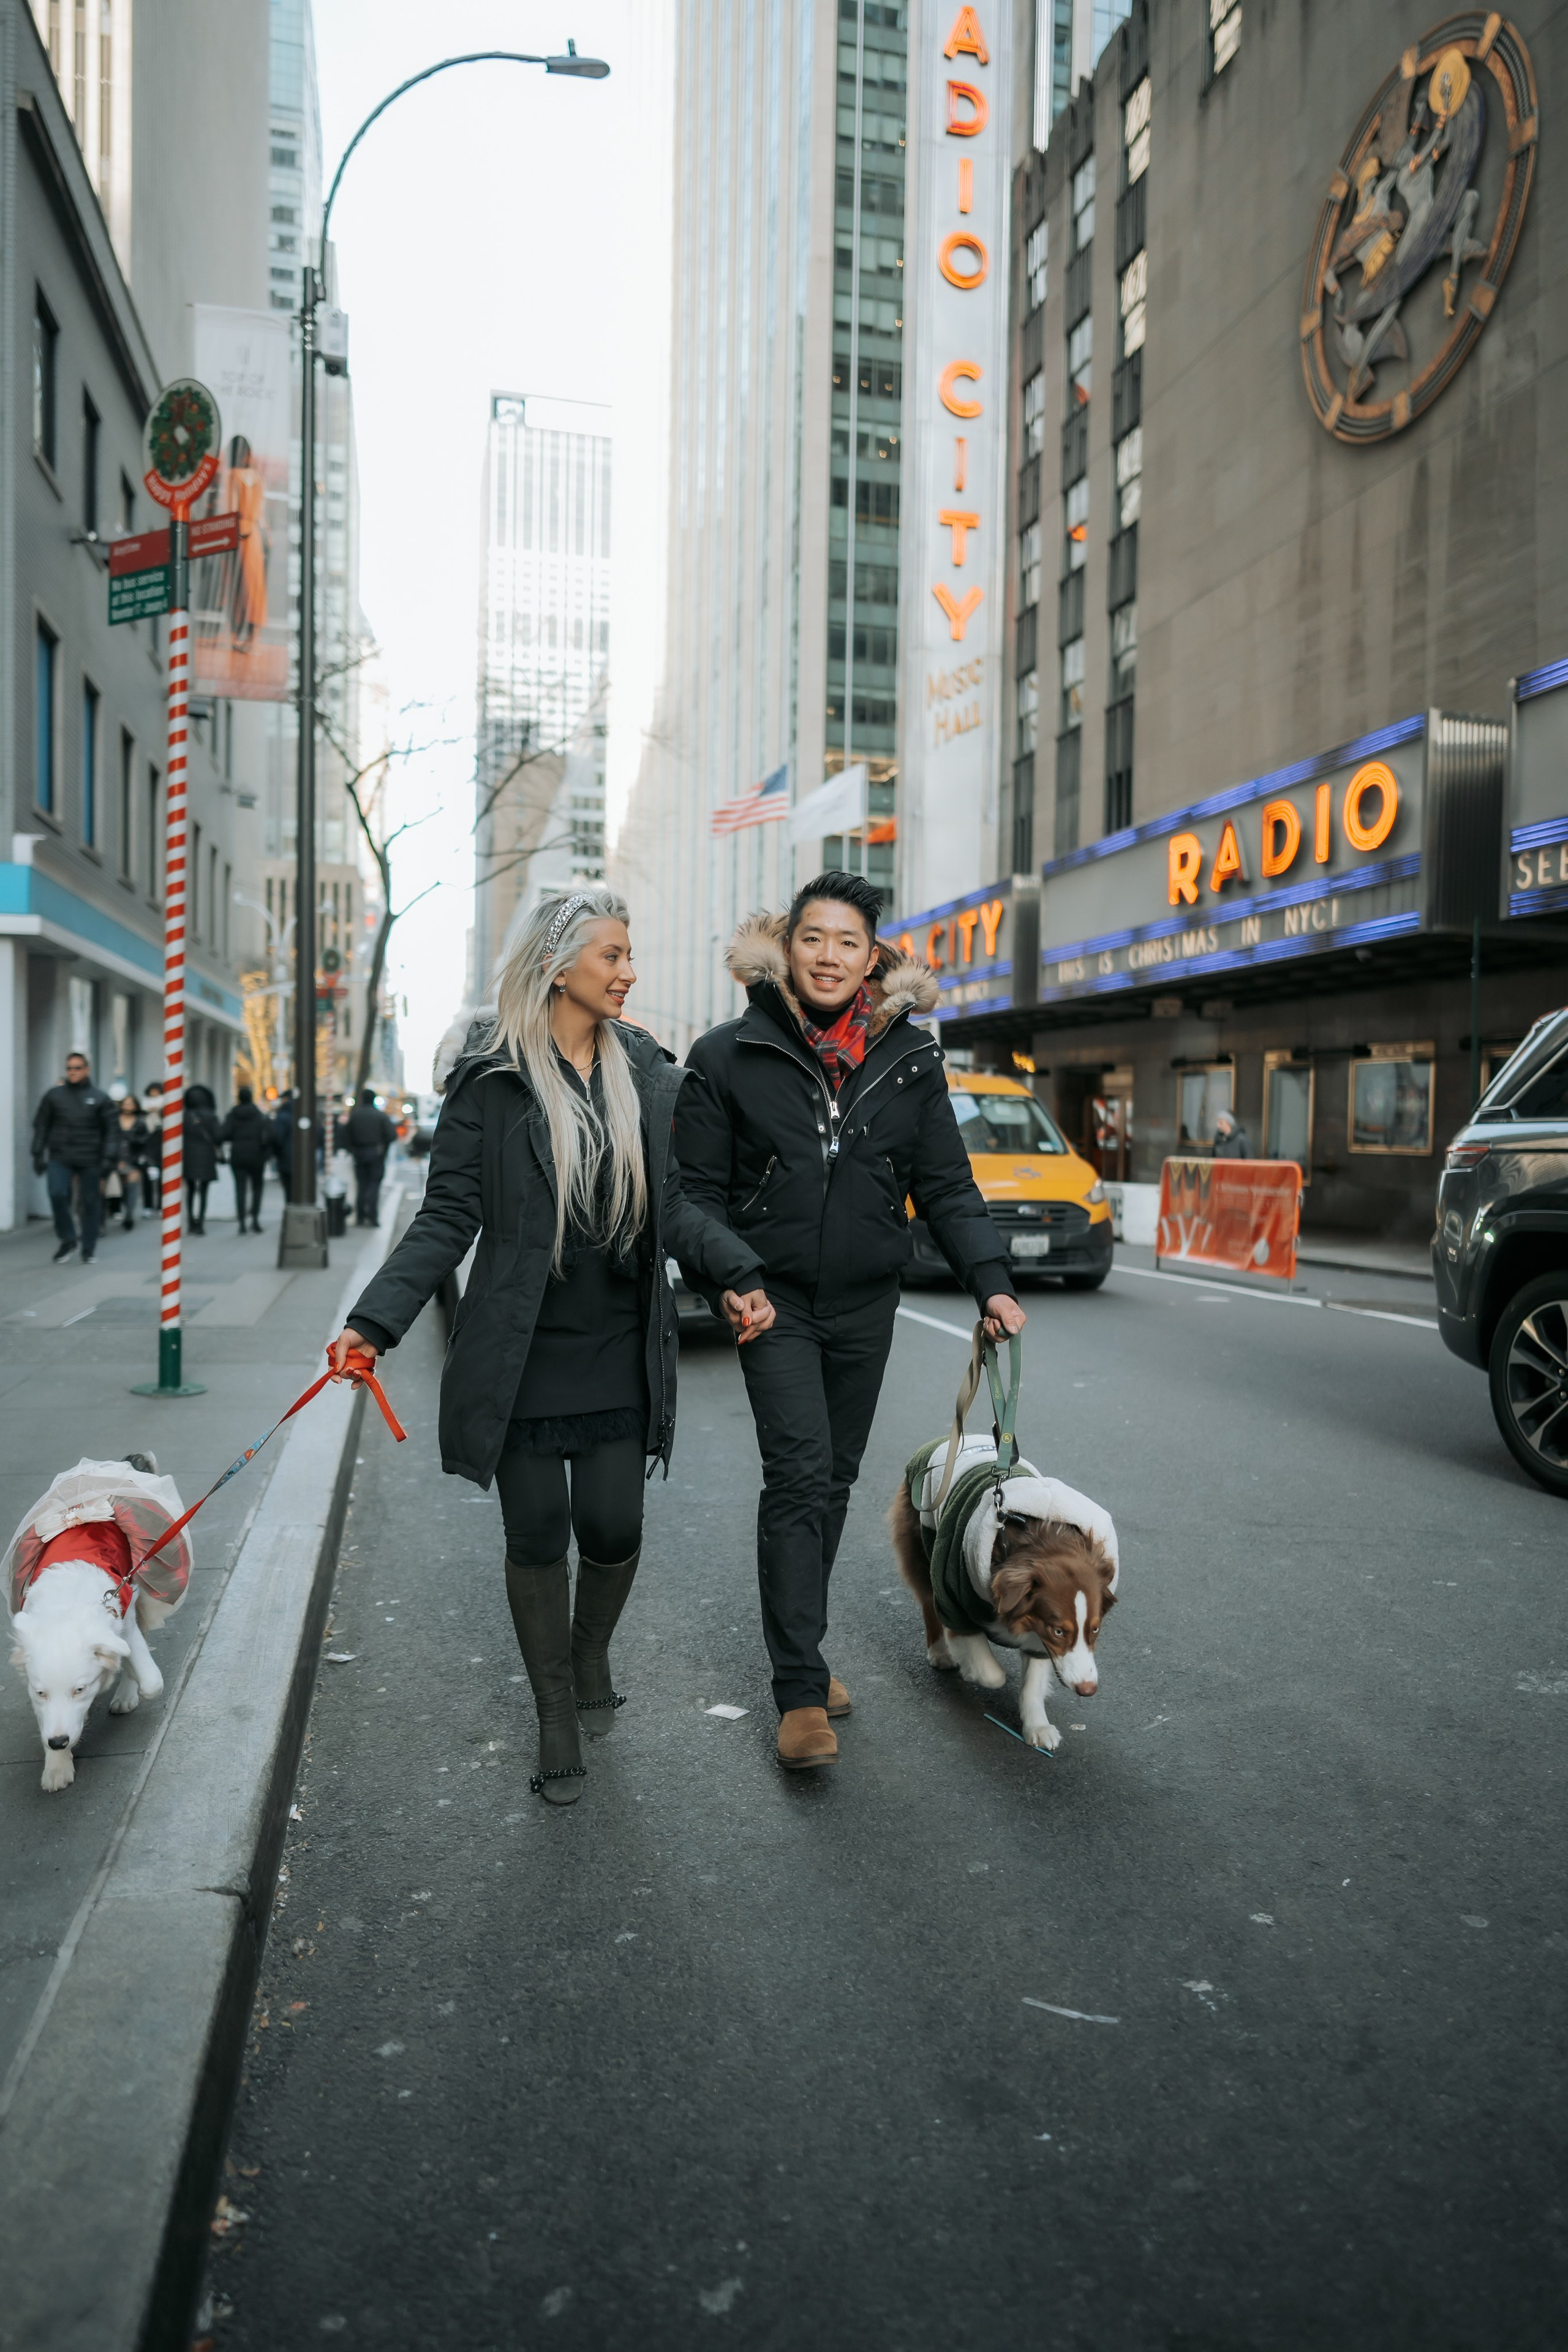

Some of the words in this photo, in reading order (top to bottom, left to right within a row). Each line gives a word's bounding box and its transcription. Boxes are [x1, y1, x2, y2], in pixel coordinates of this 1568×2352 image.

[933, 360, 984, 641] CITY
[933, 700, 982, 749] HALL
[1168, 761, 1398, 906] RADIO
[926, 899, 1003, 970] CITY
[1098, 950, 1114, 974] IS
[1128, 925, 1219, 969] CHRISTMAS
[1242, 915, 1261, 945] IN
[1284, 897, 1339, 937] NYC!
